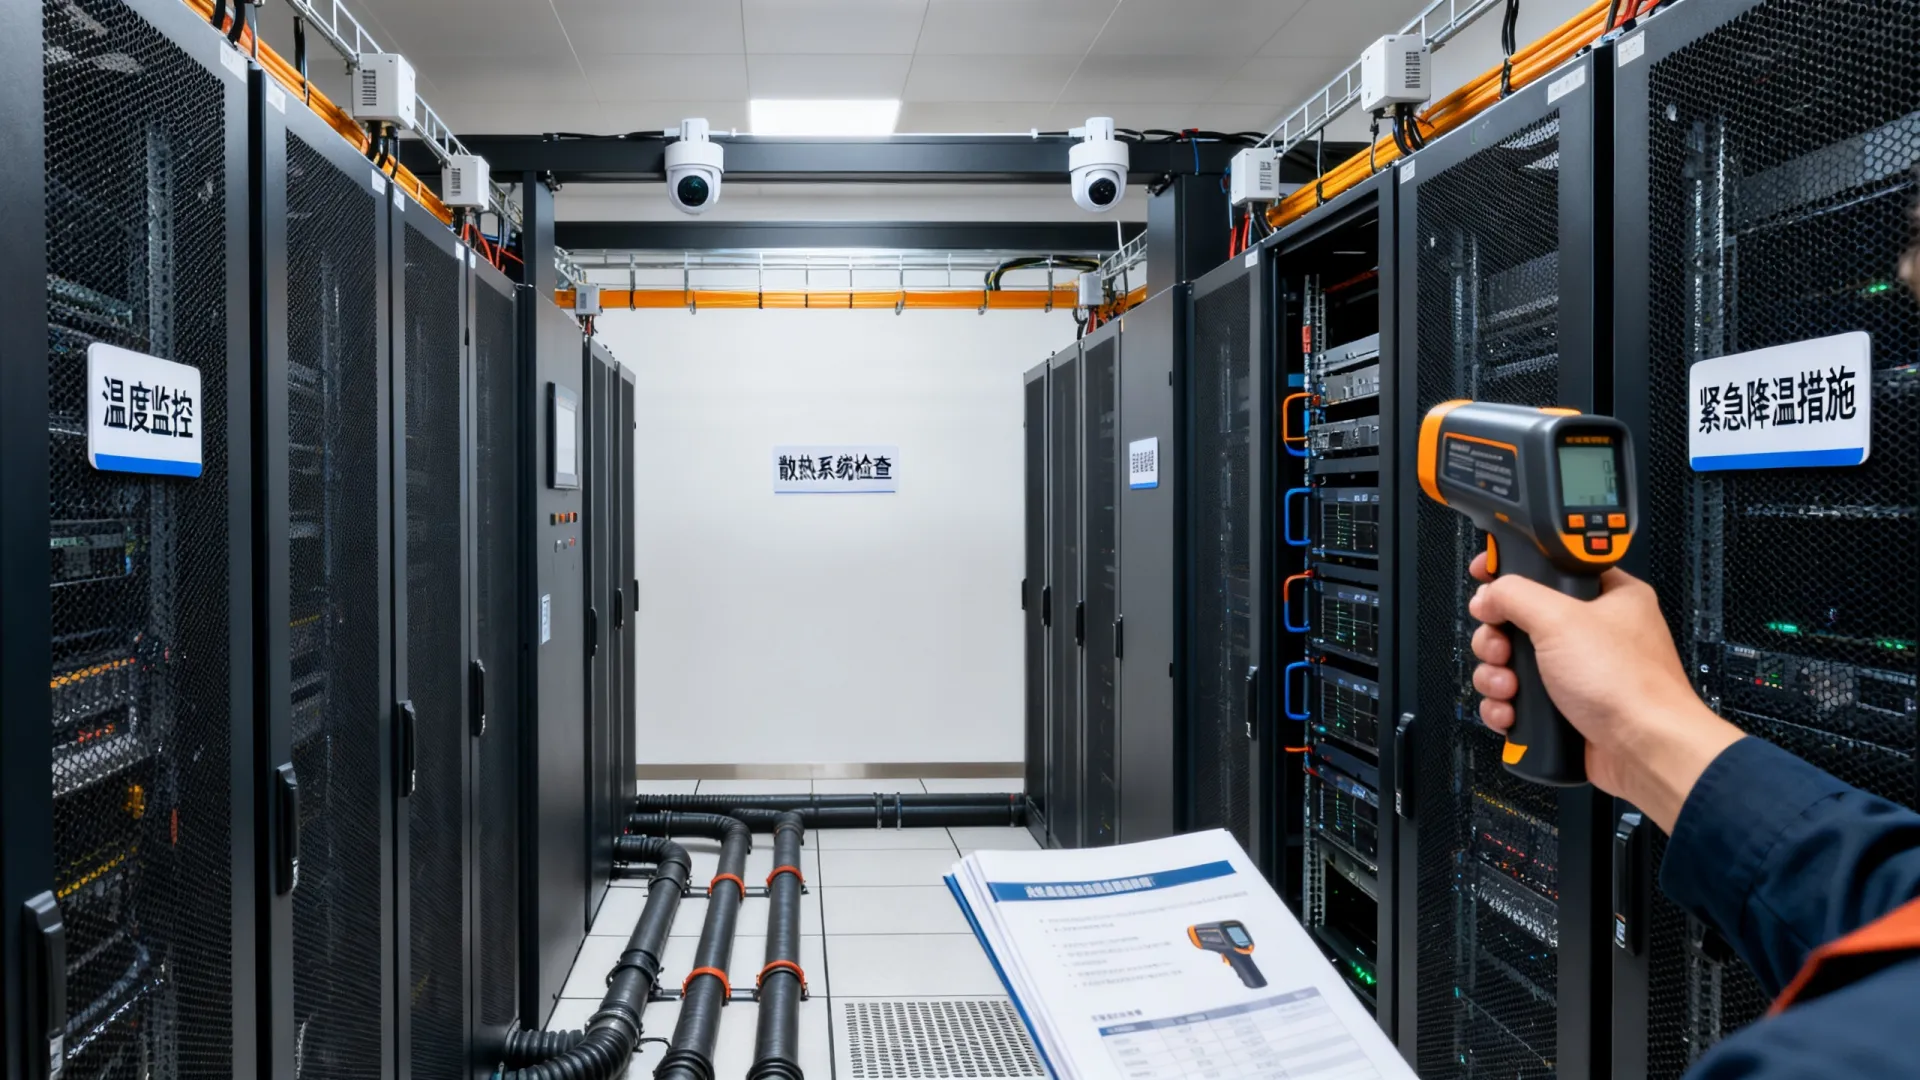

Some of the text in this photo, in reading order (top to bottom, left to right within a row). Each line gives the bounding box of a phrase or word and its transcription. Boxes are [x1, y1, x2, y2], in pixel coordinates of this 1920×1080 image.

[102, 376, 193, 438] 温度监控
[1699, 365, 1857, 434] 紧急降温措施
[778, 453, 892, 481] 散热系统检查
